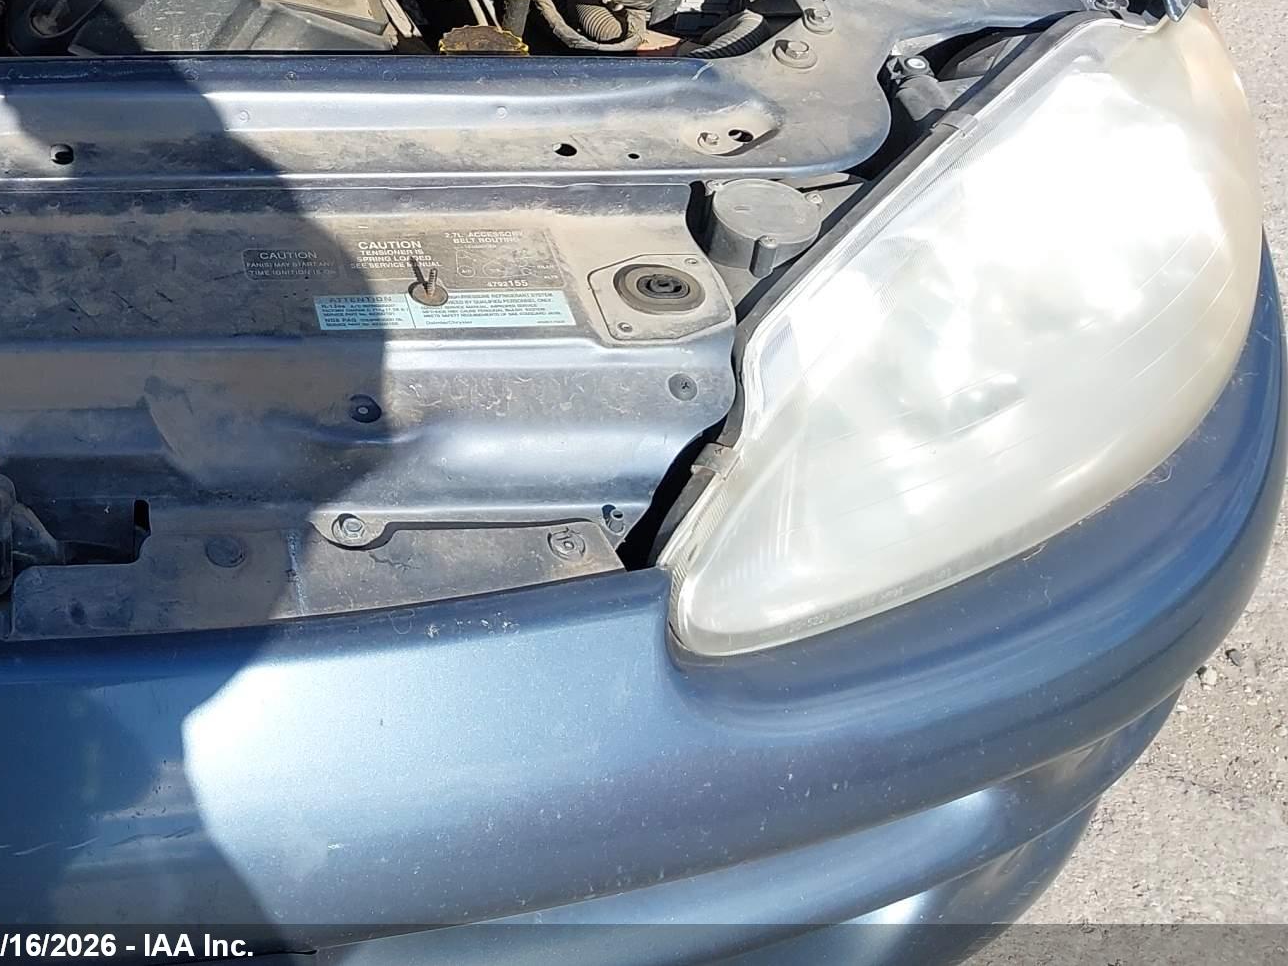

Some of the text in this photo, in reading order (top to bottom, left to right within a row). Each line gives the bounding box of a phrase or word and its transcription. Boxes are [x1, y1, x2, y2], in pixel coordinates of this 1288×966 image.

[358, 240, 422, 250] CAUTION
[259, 251, 318, 260] CAUTION
[356, 255, 392, 263] SPRING
[329, 296, 393, 304] ATTENTION
